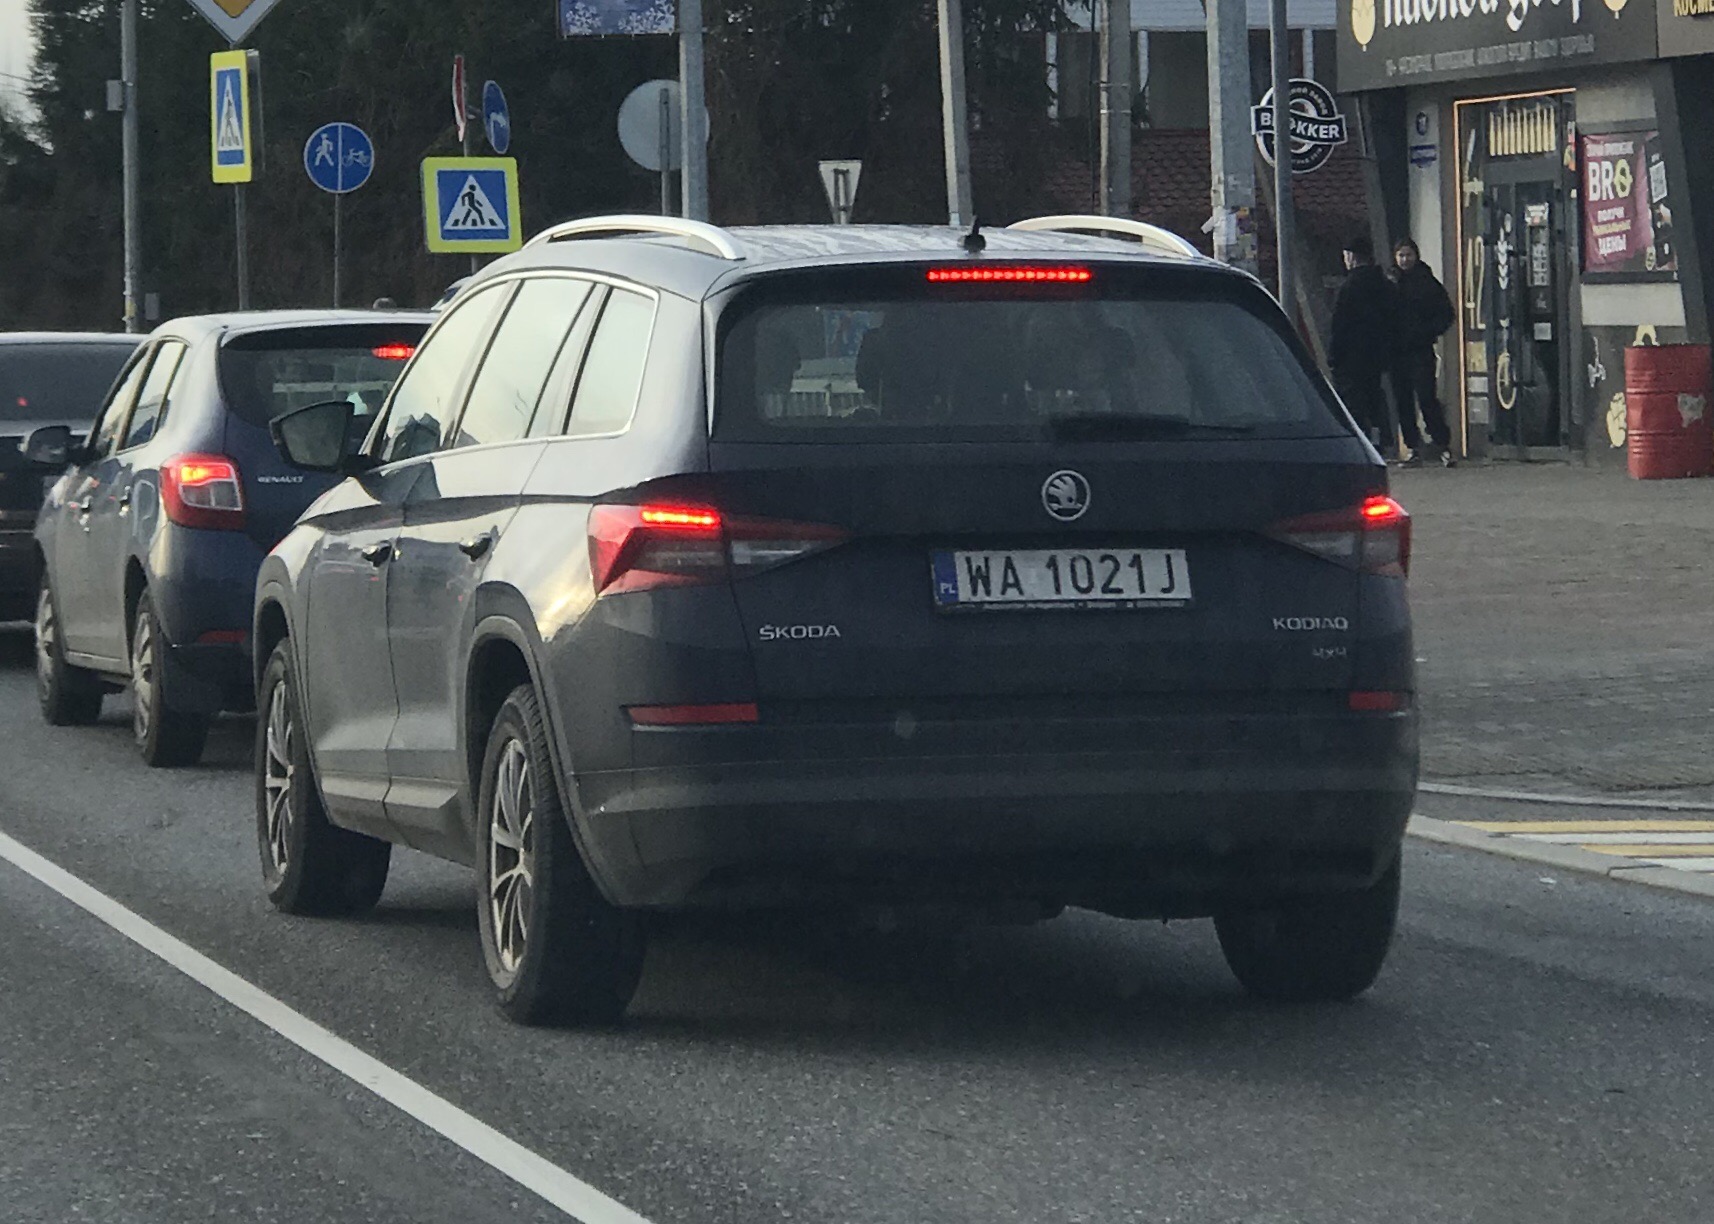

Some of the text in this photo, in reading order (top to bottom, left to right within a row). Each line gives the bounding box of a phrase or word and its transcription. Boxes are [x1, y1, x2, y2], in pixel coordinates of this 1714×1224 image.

[965, 553, 1176, 597] WA 1021J
[939, 582, 956, 595] PL
[759, 623, 841, 640] ŠKODA
[1273, 616, 1349, 632] KODIAQ
